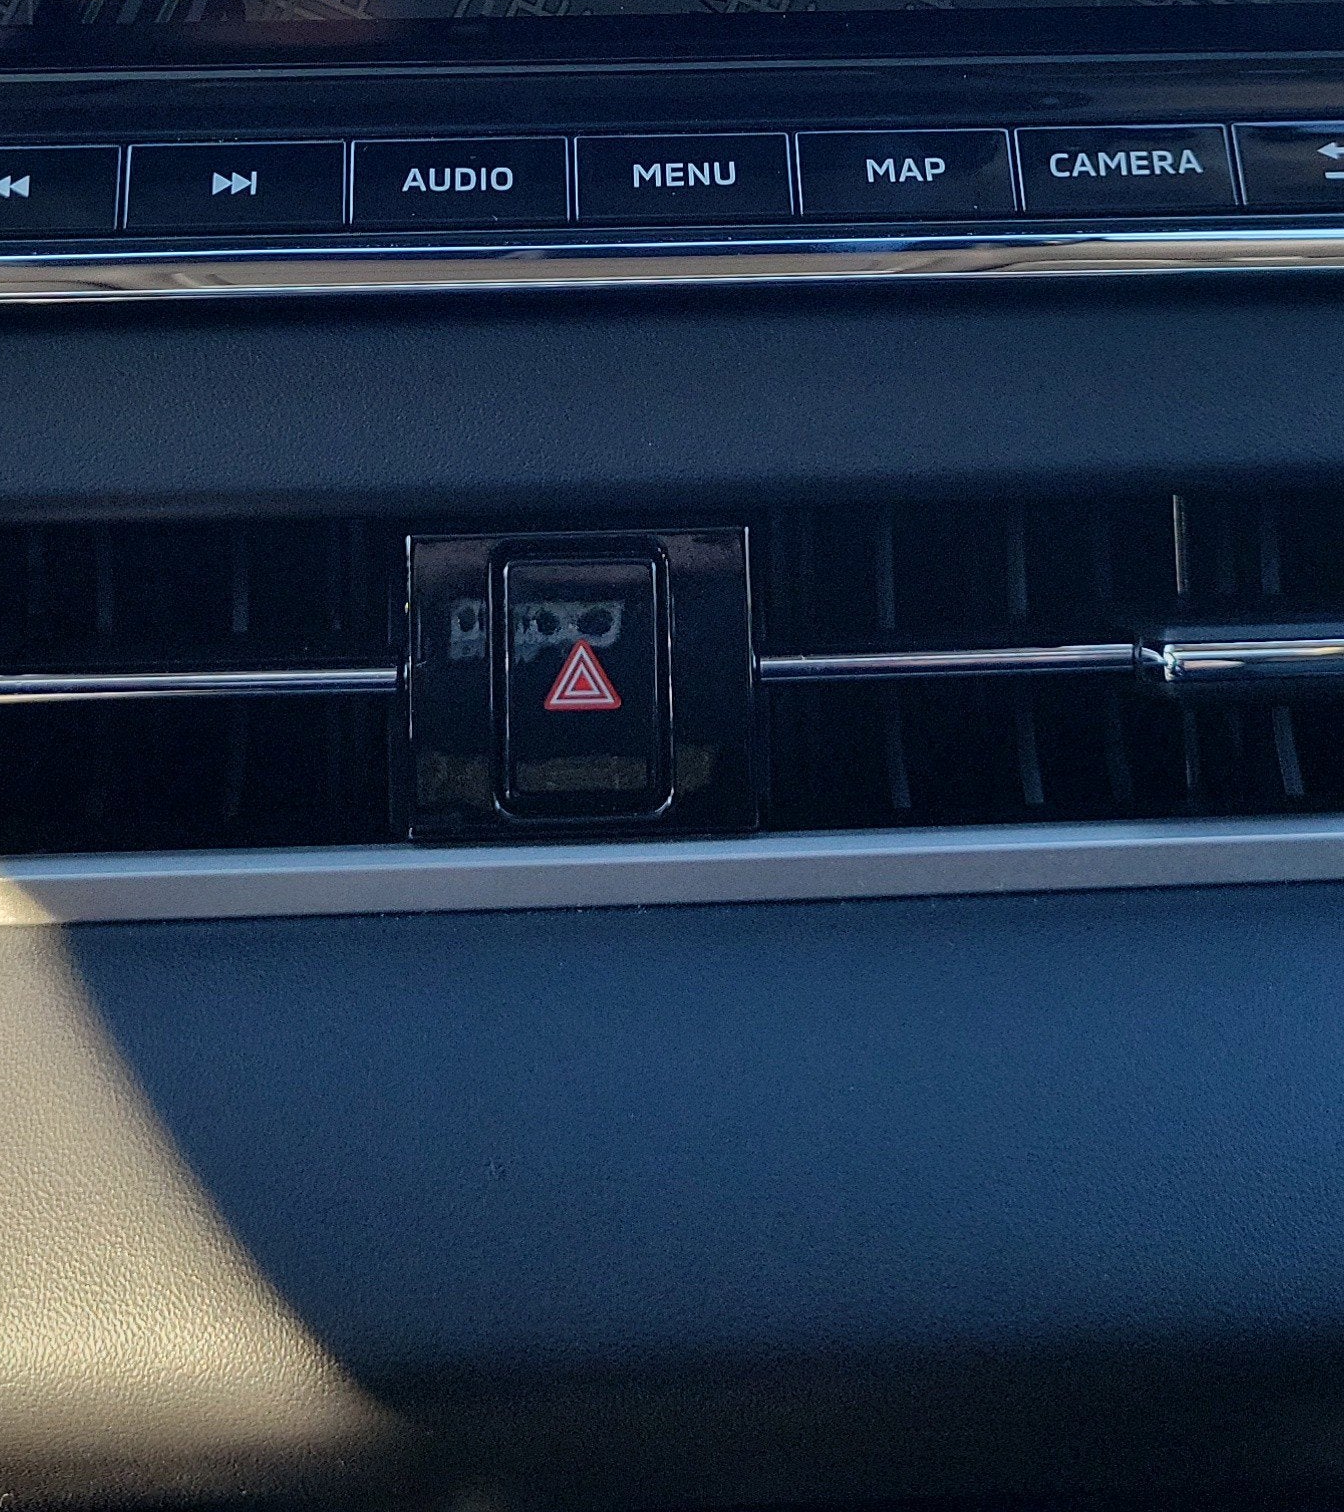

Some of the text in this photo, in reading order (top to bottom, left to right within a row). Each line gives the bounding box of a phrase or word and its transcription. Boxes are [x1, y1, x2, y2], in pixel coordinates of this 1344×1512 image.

[632, 161, 737, 188] MENU
[865, 156, 946, 183] MAP
[1049, 149, 1203, 179] CAMERA
[402, 166, 514, 193] AUDIO
